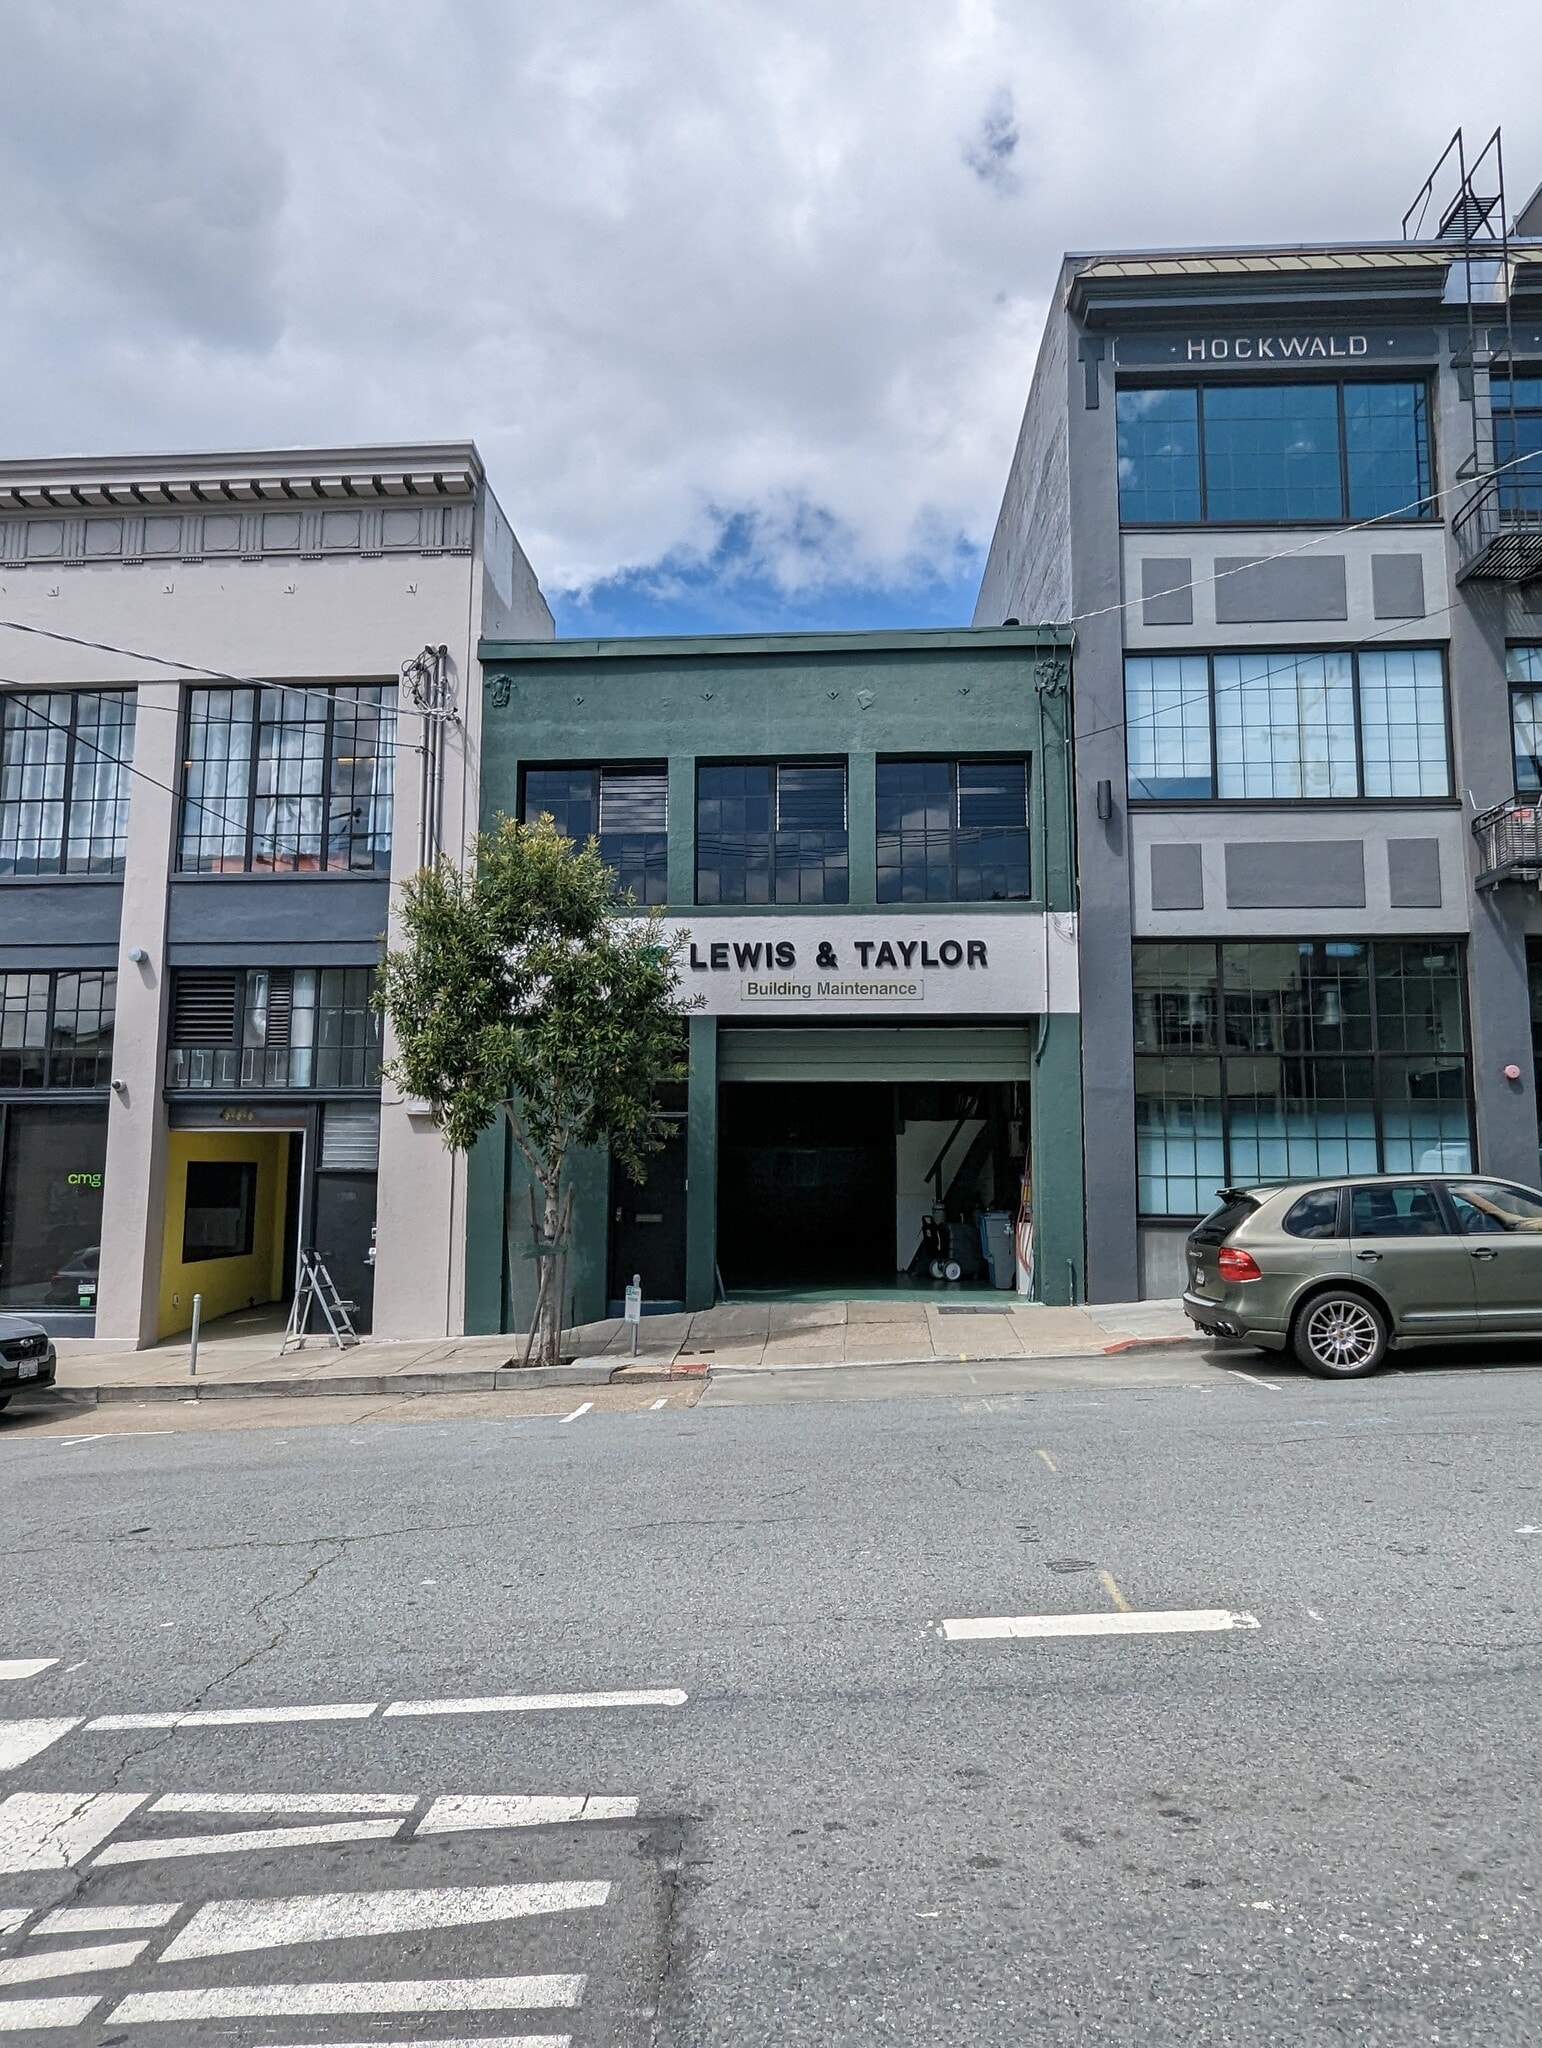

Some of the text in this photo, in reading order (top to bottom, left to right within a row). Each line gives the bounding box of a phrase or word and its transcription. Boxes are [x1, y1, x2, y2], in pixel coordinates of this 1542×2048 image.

[1187, 336, 1367, 360] HOCKWALD
[690, 940, 988, 969] LEWIS & TAYLOR
[747, 981, 917, 998] Building Maintenance
[68, 1173, 102, 1188] cmg
